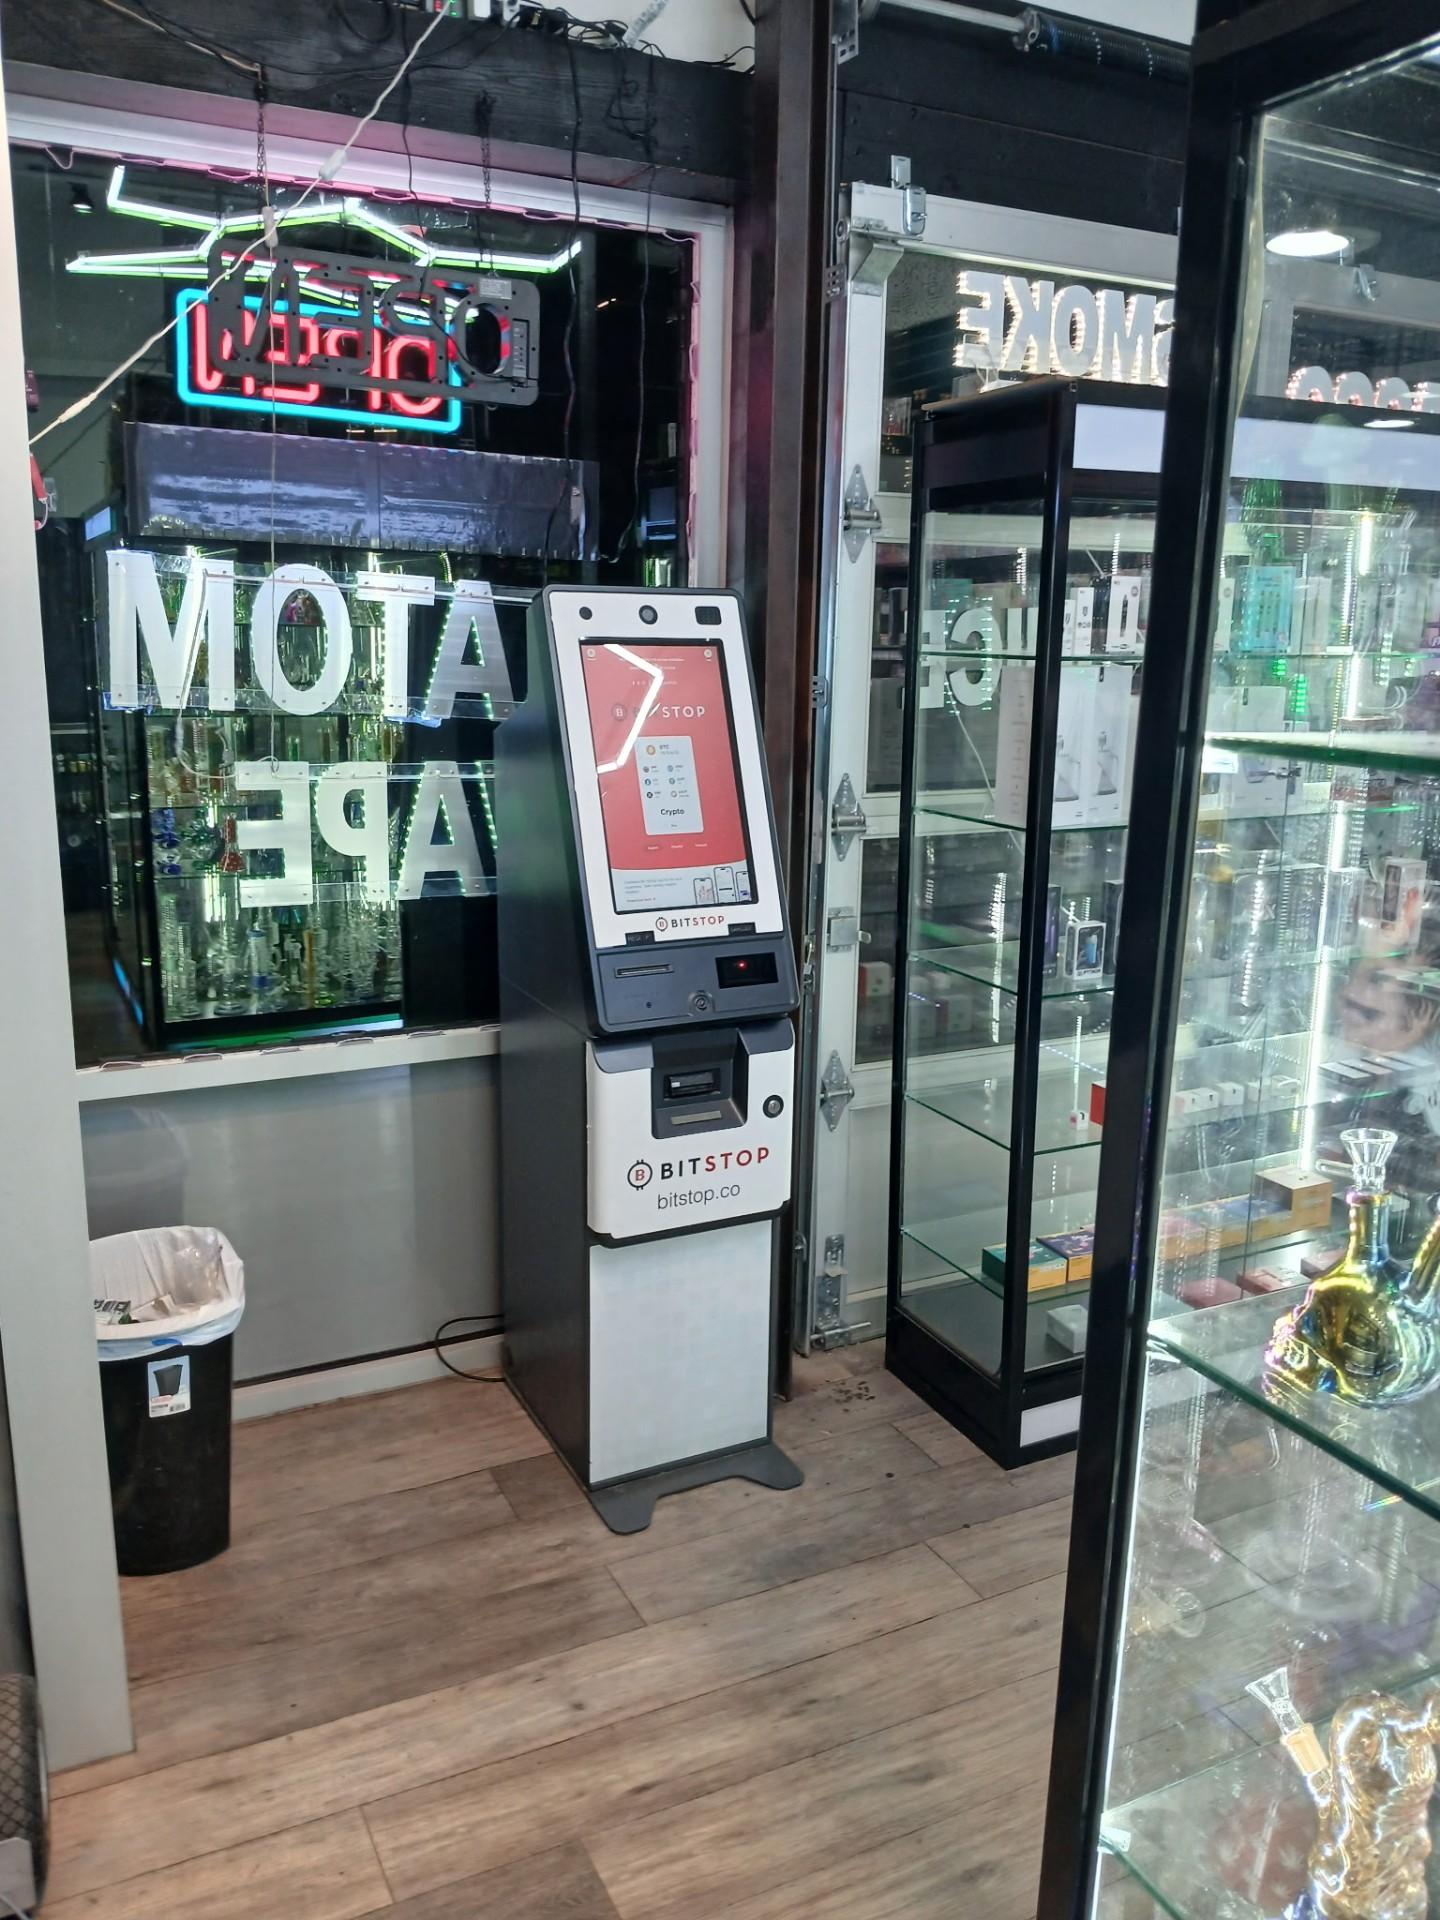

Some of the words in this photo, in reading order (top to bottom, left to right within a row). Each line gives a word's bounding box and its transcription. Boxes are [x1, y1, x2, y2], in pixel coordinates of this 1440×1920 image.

[660, 808, 685, 817] Crypto
[671, 915, 725, 928] BITSTOP
[660, 1147, 770, 1181] BITSTOP
[657, 1184, 741, 1210] bitstop.co
